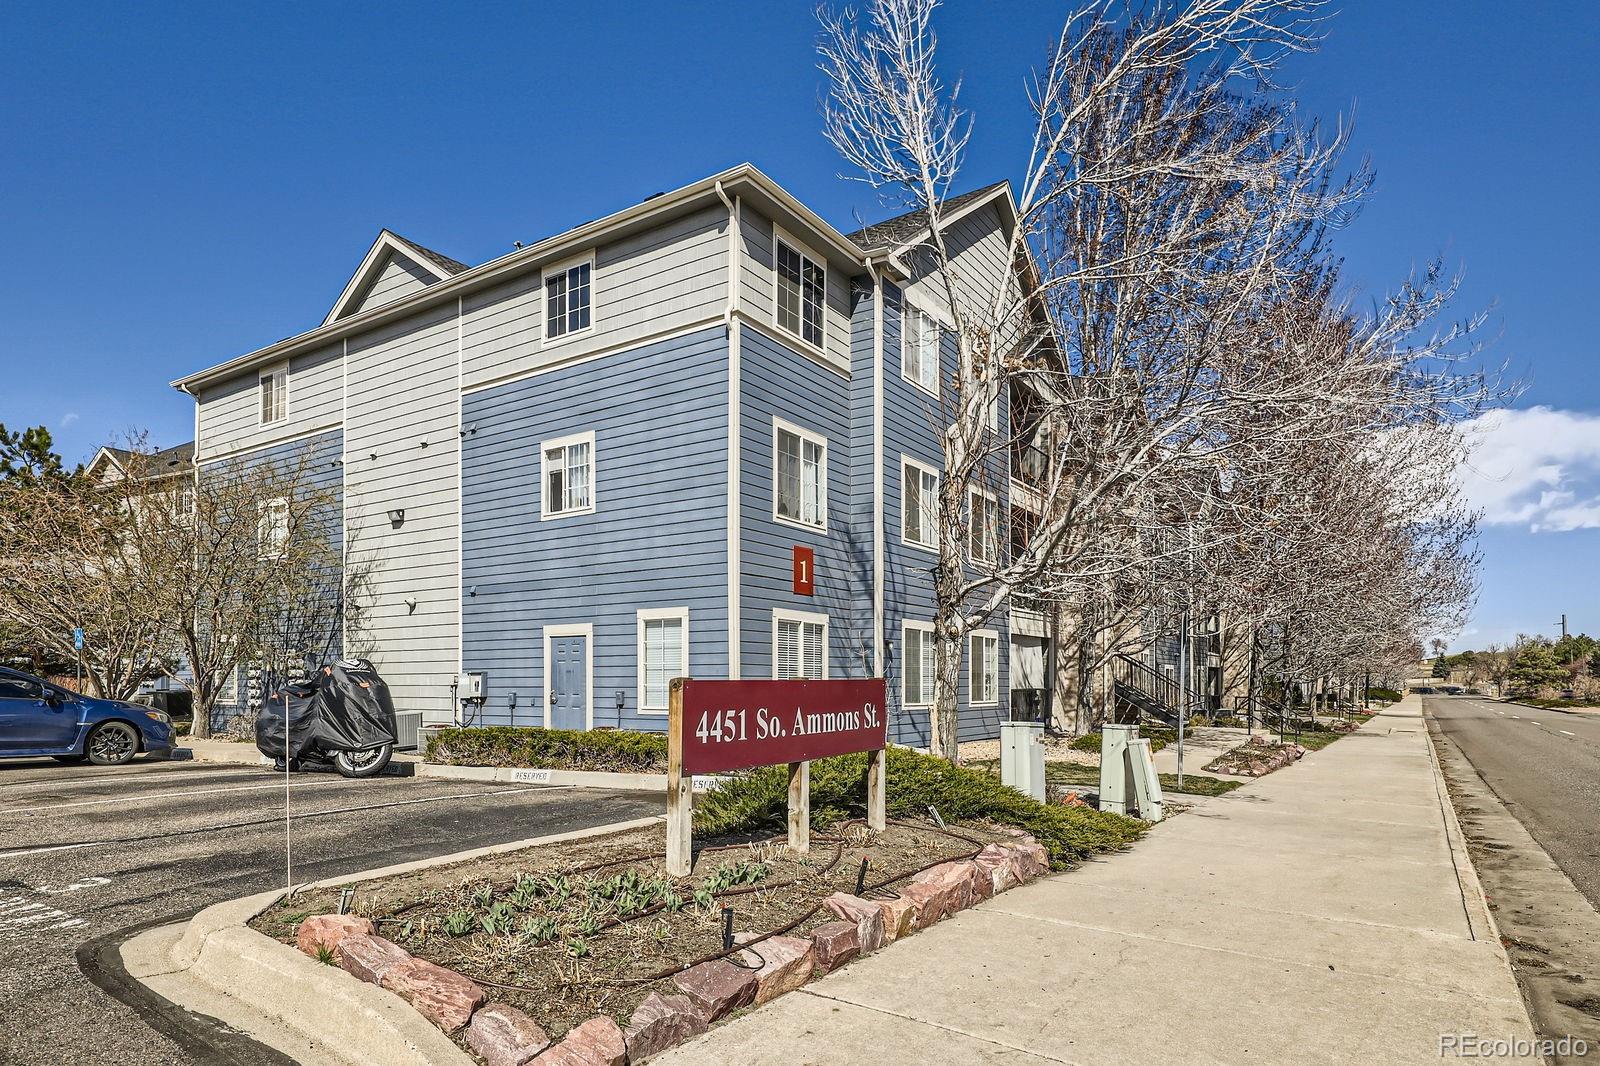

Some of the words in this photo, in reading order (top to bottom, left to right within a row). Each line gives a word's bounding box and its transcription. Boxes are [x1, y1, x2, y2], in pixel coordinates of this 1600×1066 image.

[800, 560, 808, 583] 1
[696, 709, 747, 743] 4451
[757, 708, 786, 739] So.
[791, 706, 860, 736] Ammons
[864, 702, 880, 729] St.
[515, 772, 547, 780] RESERVED
